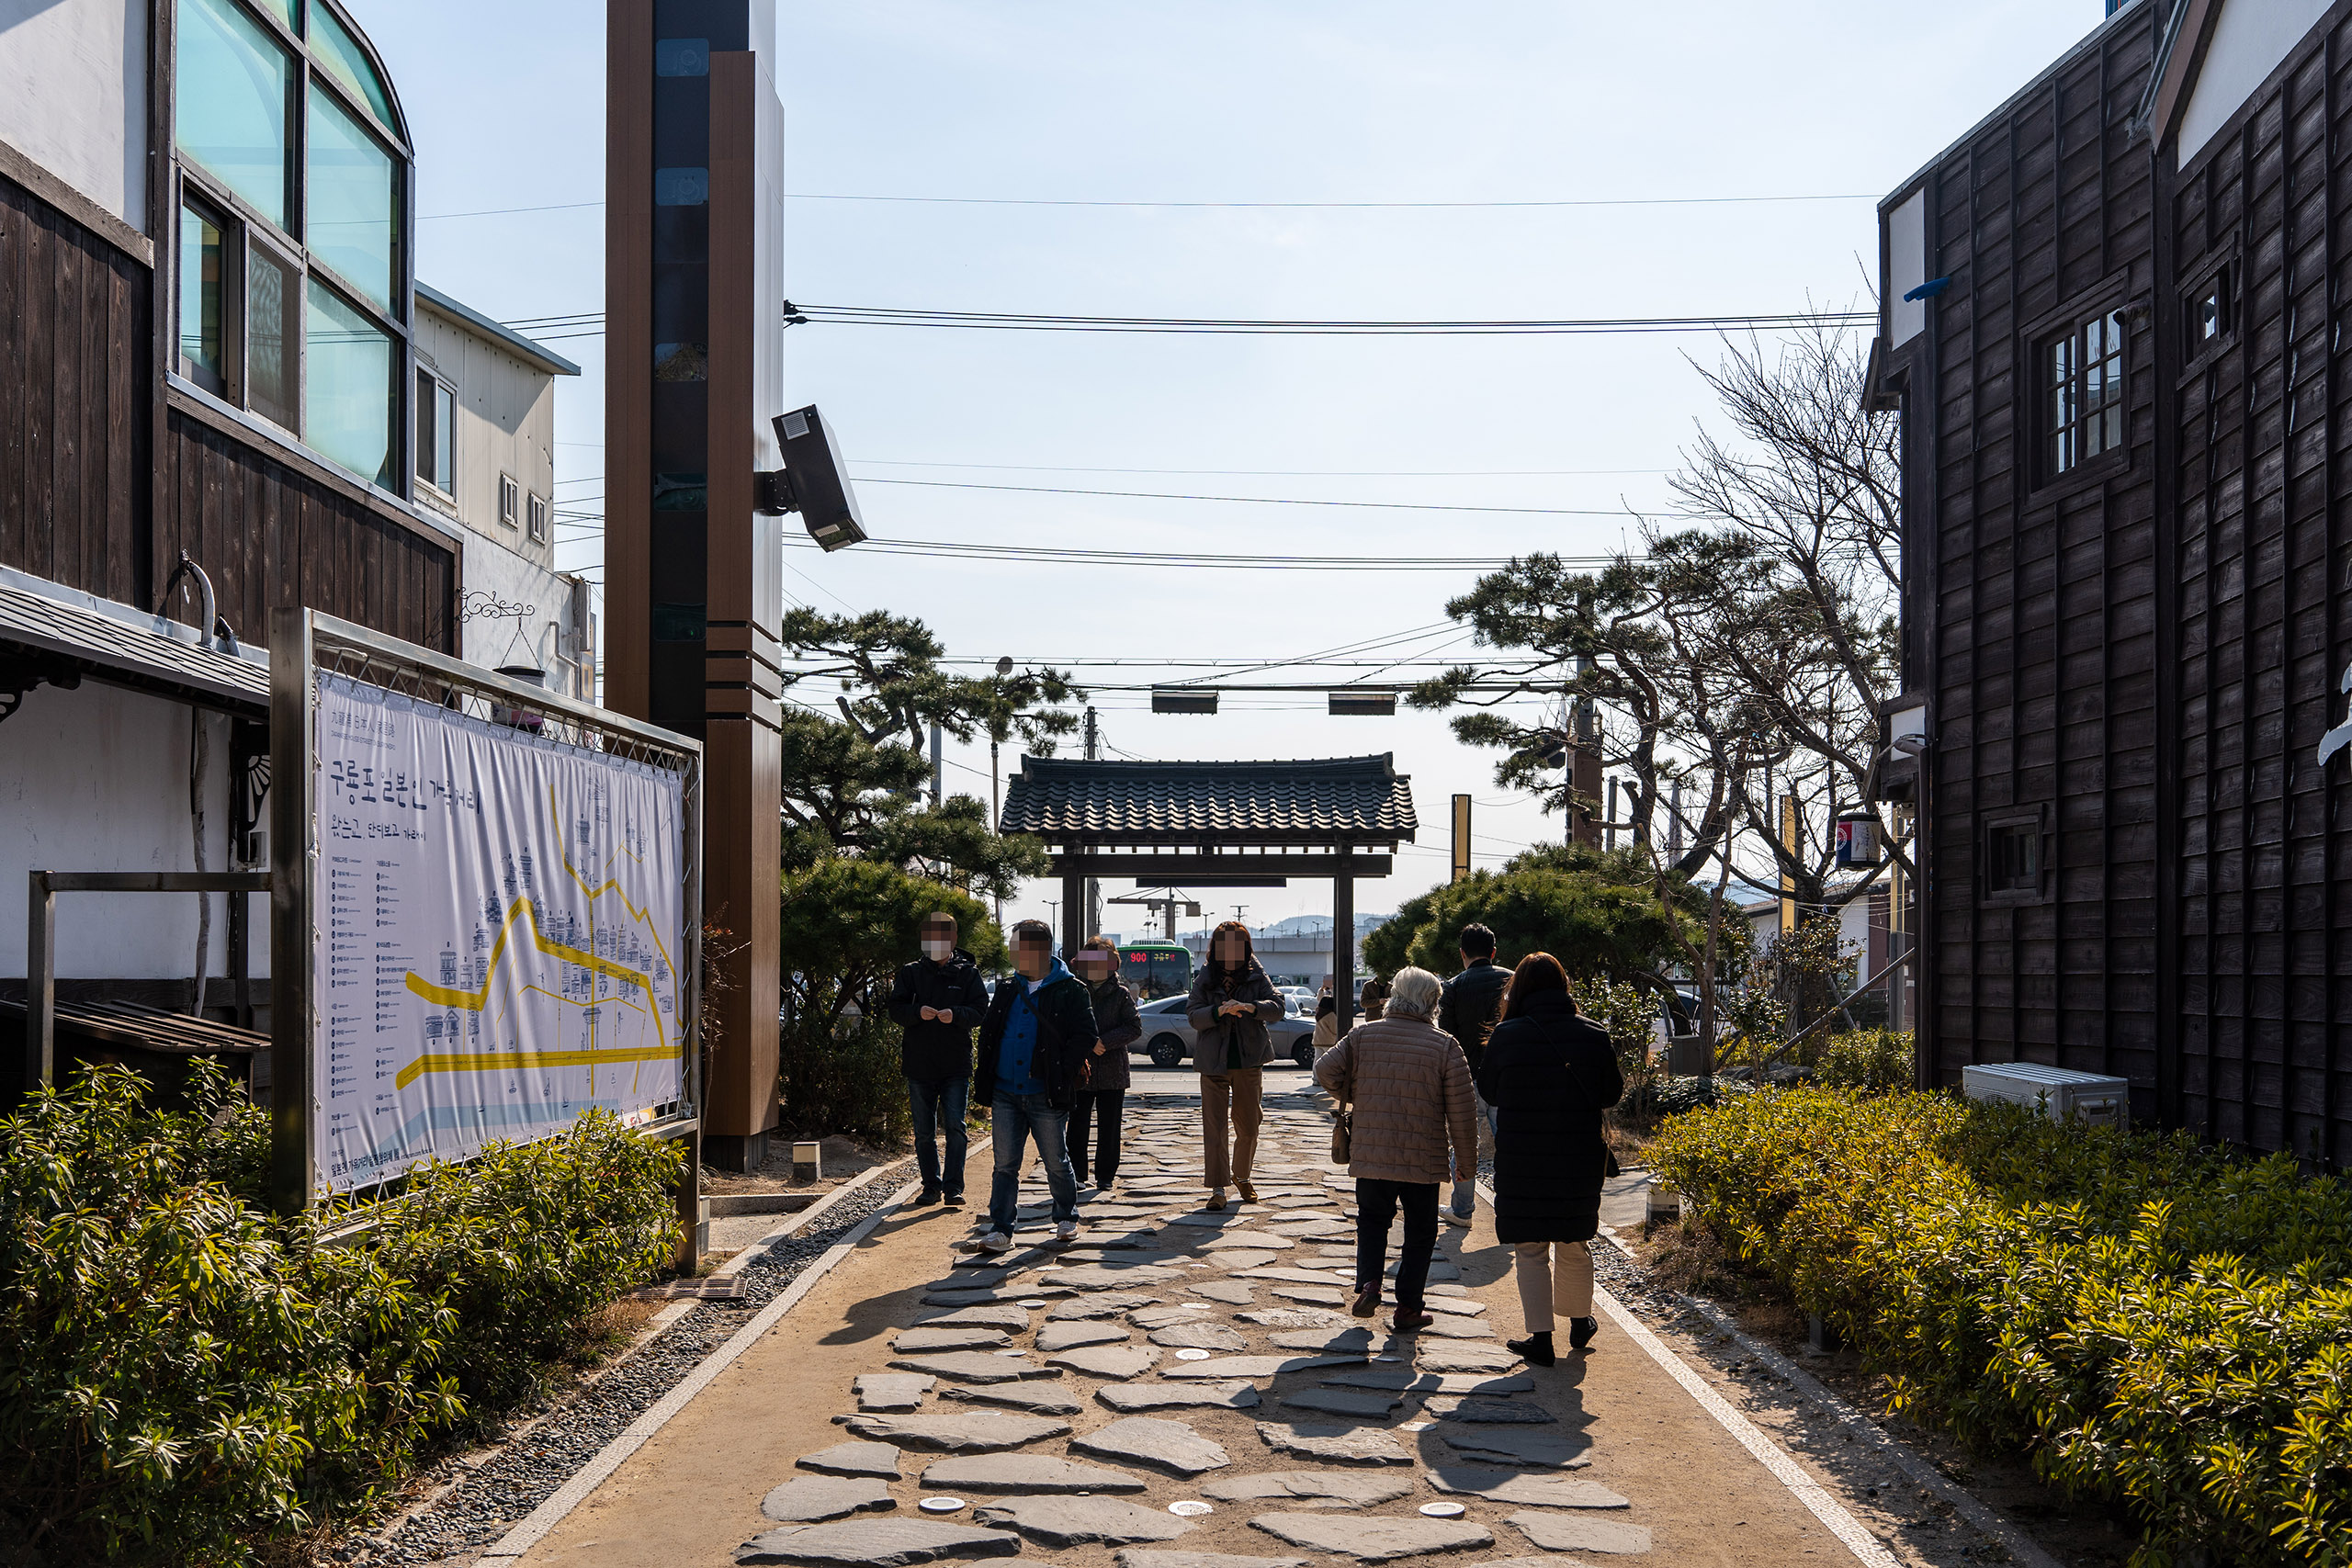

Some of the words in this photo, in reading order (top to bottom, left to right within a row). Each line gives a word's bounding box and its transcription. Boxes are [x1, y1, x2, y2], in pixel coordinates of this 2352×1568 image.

[355, 715, 375, 733] 日本人
[331, 760, 377, 805] 구룡포
[380, 767, 427, 810] 일본인
[368, 821, 400, 839] 단디보고
[1130, 952, 1147, 963] 900
[331, 1160, 348, 1178] 일본인
[348, 1155, 368, 1172] 가옥거리
